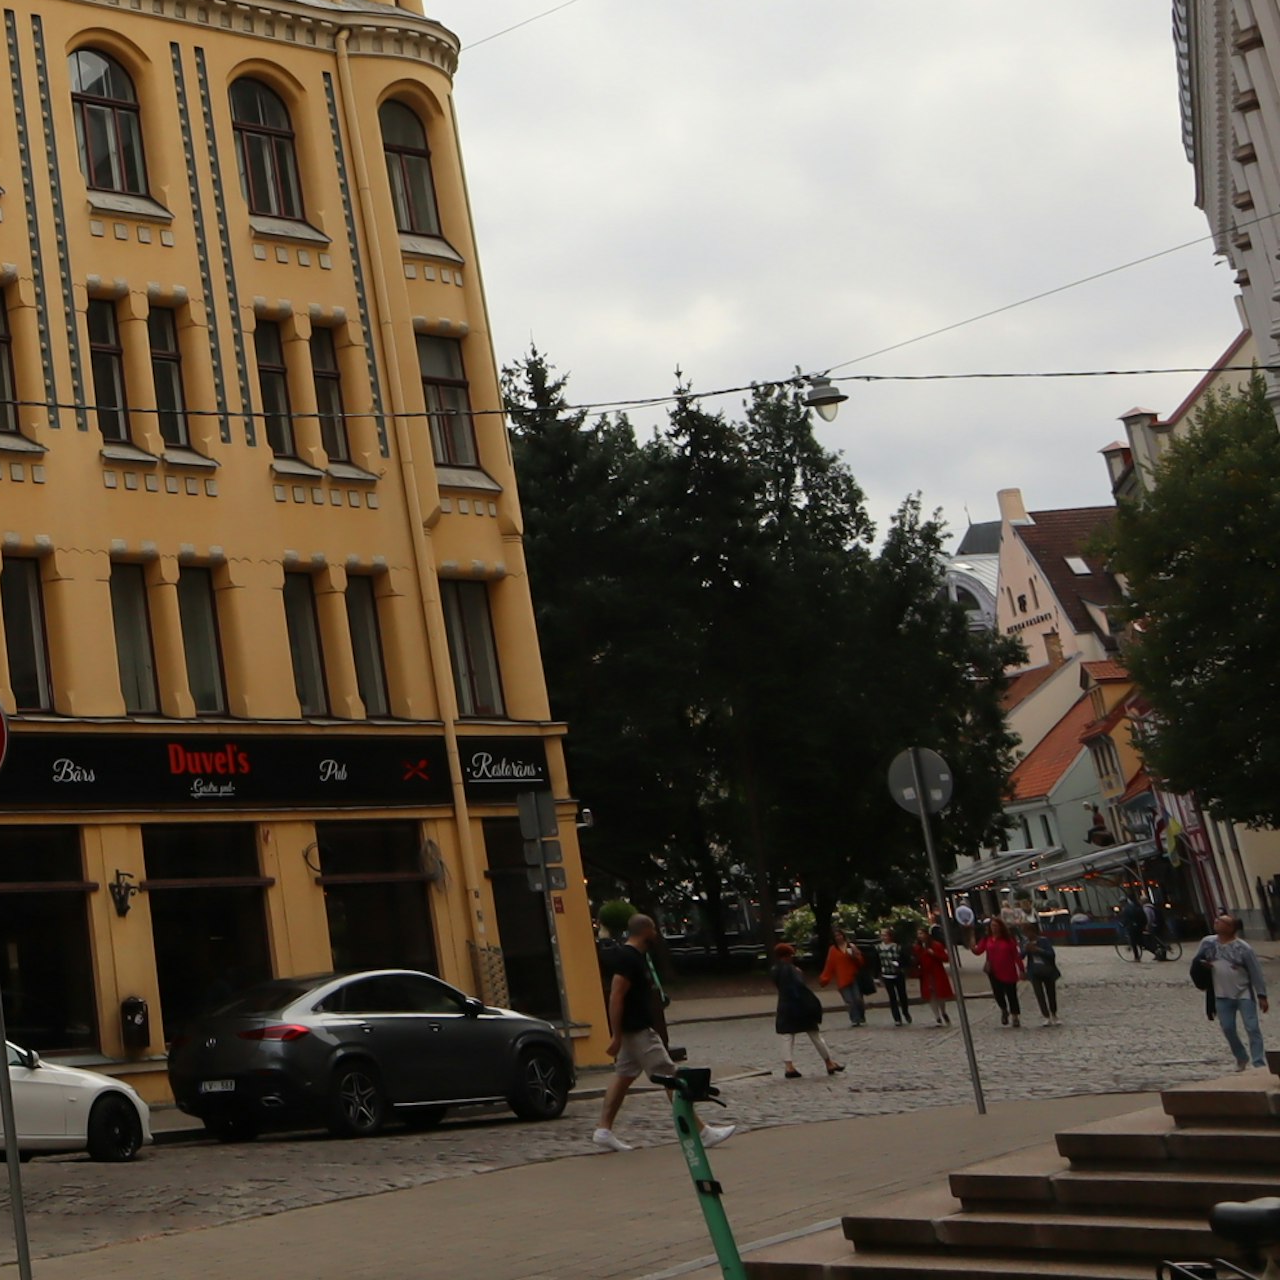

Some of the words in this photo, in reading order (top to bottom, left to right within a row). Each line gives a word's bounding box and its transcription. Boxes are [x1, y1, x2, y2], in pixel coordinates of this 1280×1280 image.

[52, 758, 96, 783] Bārs
[168, 742, 252, 777] Duvel's
[319, 758, 348, 783] Pub
[471, 752, 537, 780] Restorāns
